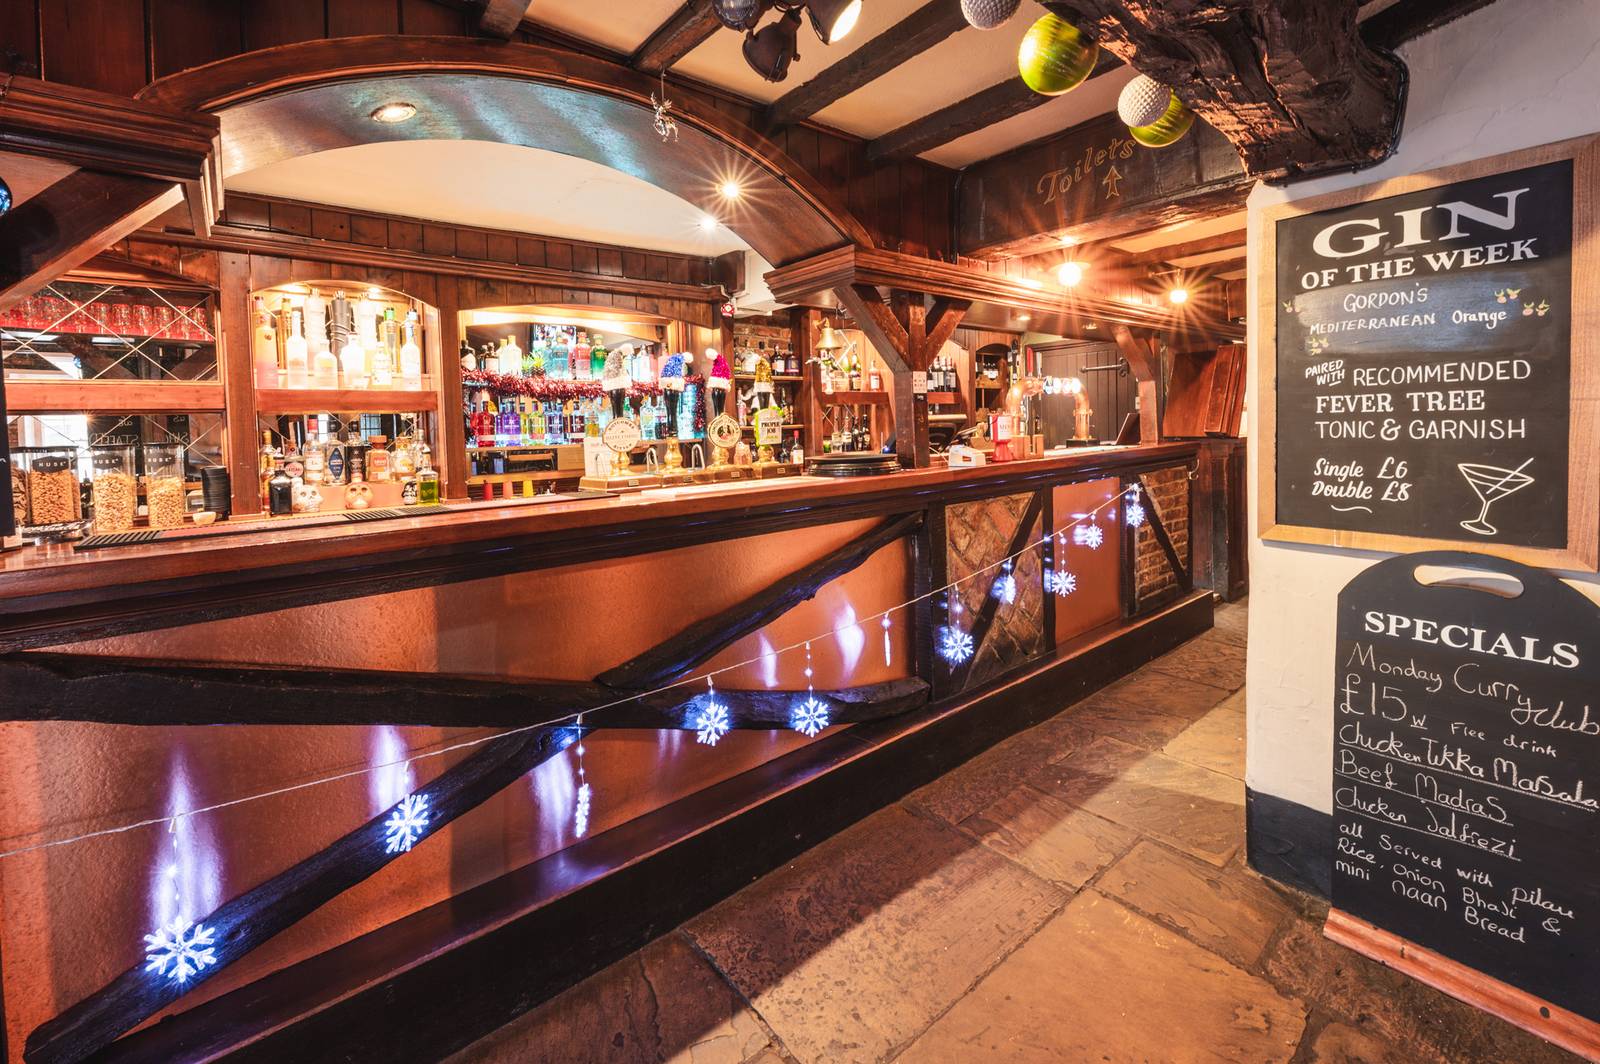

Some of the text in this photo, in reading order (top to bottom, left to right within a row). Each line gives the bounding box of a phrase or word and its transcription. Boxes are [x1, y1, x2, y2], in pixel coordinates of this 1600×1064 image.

[1037, 137, 1136, 205] Toilets
[1312, 188, 1530, 259] GIN
[1301, 238, 1539, 290] OF THE WEEK
[1343, 282, 1429, 313] GORDON'S
[1309, 308, 1507, 335] MEDITERRANEAN Orange
[1305, 359, 1344, 379] PAIRED
[1316, 369, 1345, 386] WITH
[1353, 359, 1531, 387] RECOMMENDED
[1316, 389, 1485, 413] FEVER TREE
[1315, 418, 1526, 442] TONIC & GARNISH
[1313, 456, 1408, 482] Single £6
[1311, 480, 1412, 502] Double £8
[1364, 611, 1580, 669] SPECIALS
[1346, 642, 1443, 693] Monday
[1340, 673, 1407, 722] £15
[1503, 734, 1558, 758] drink
[1340, 749, 1398, 790] Beef
[1457, 868, 1494, 888] with
[1393, 863, 1446, 893] Onion
[1542, 918, 1561, 936] &
[1465, 906, 1526, 943] Bread
